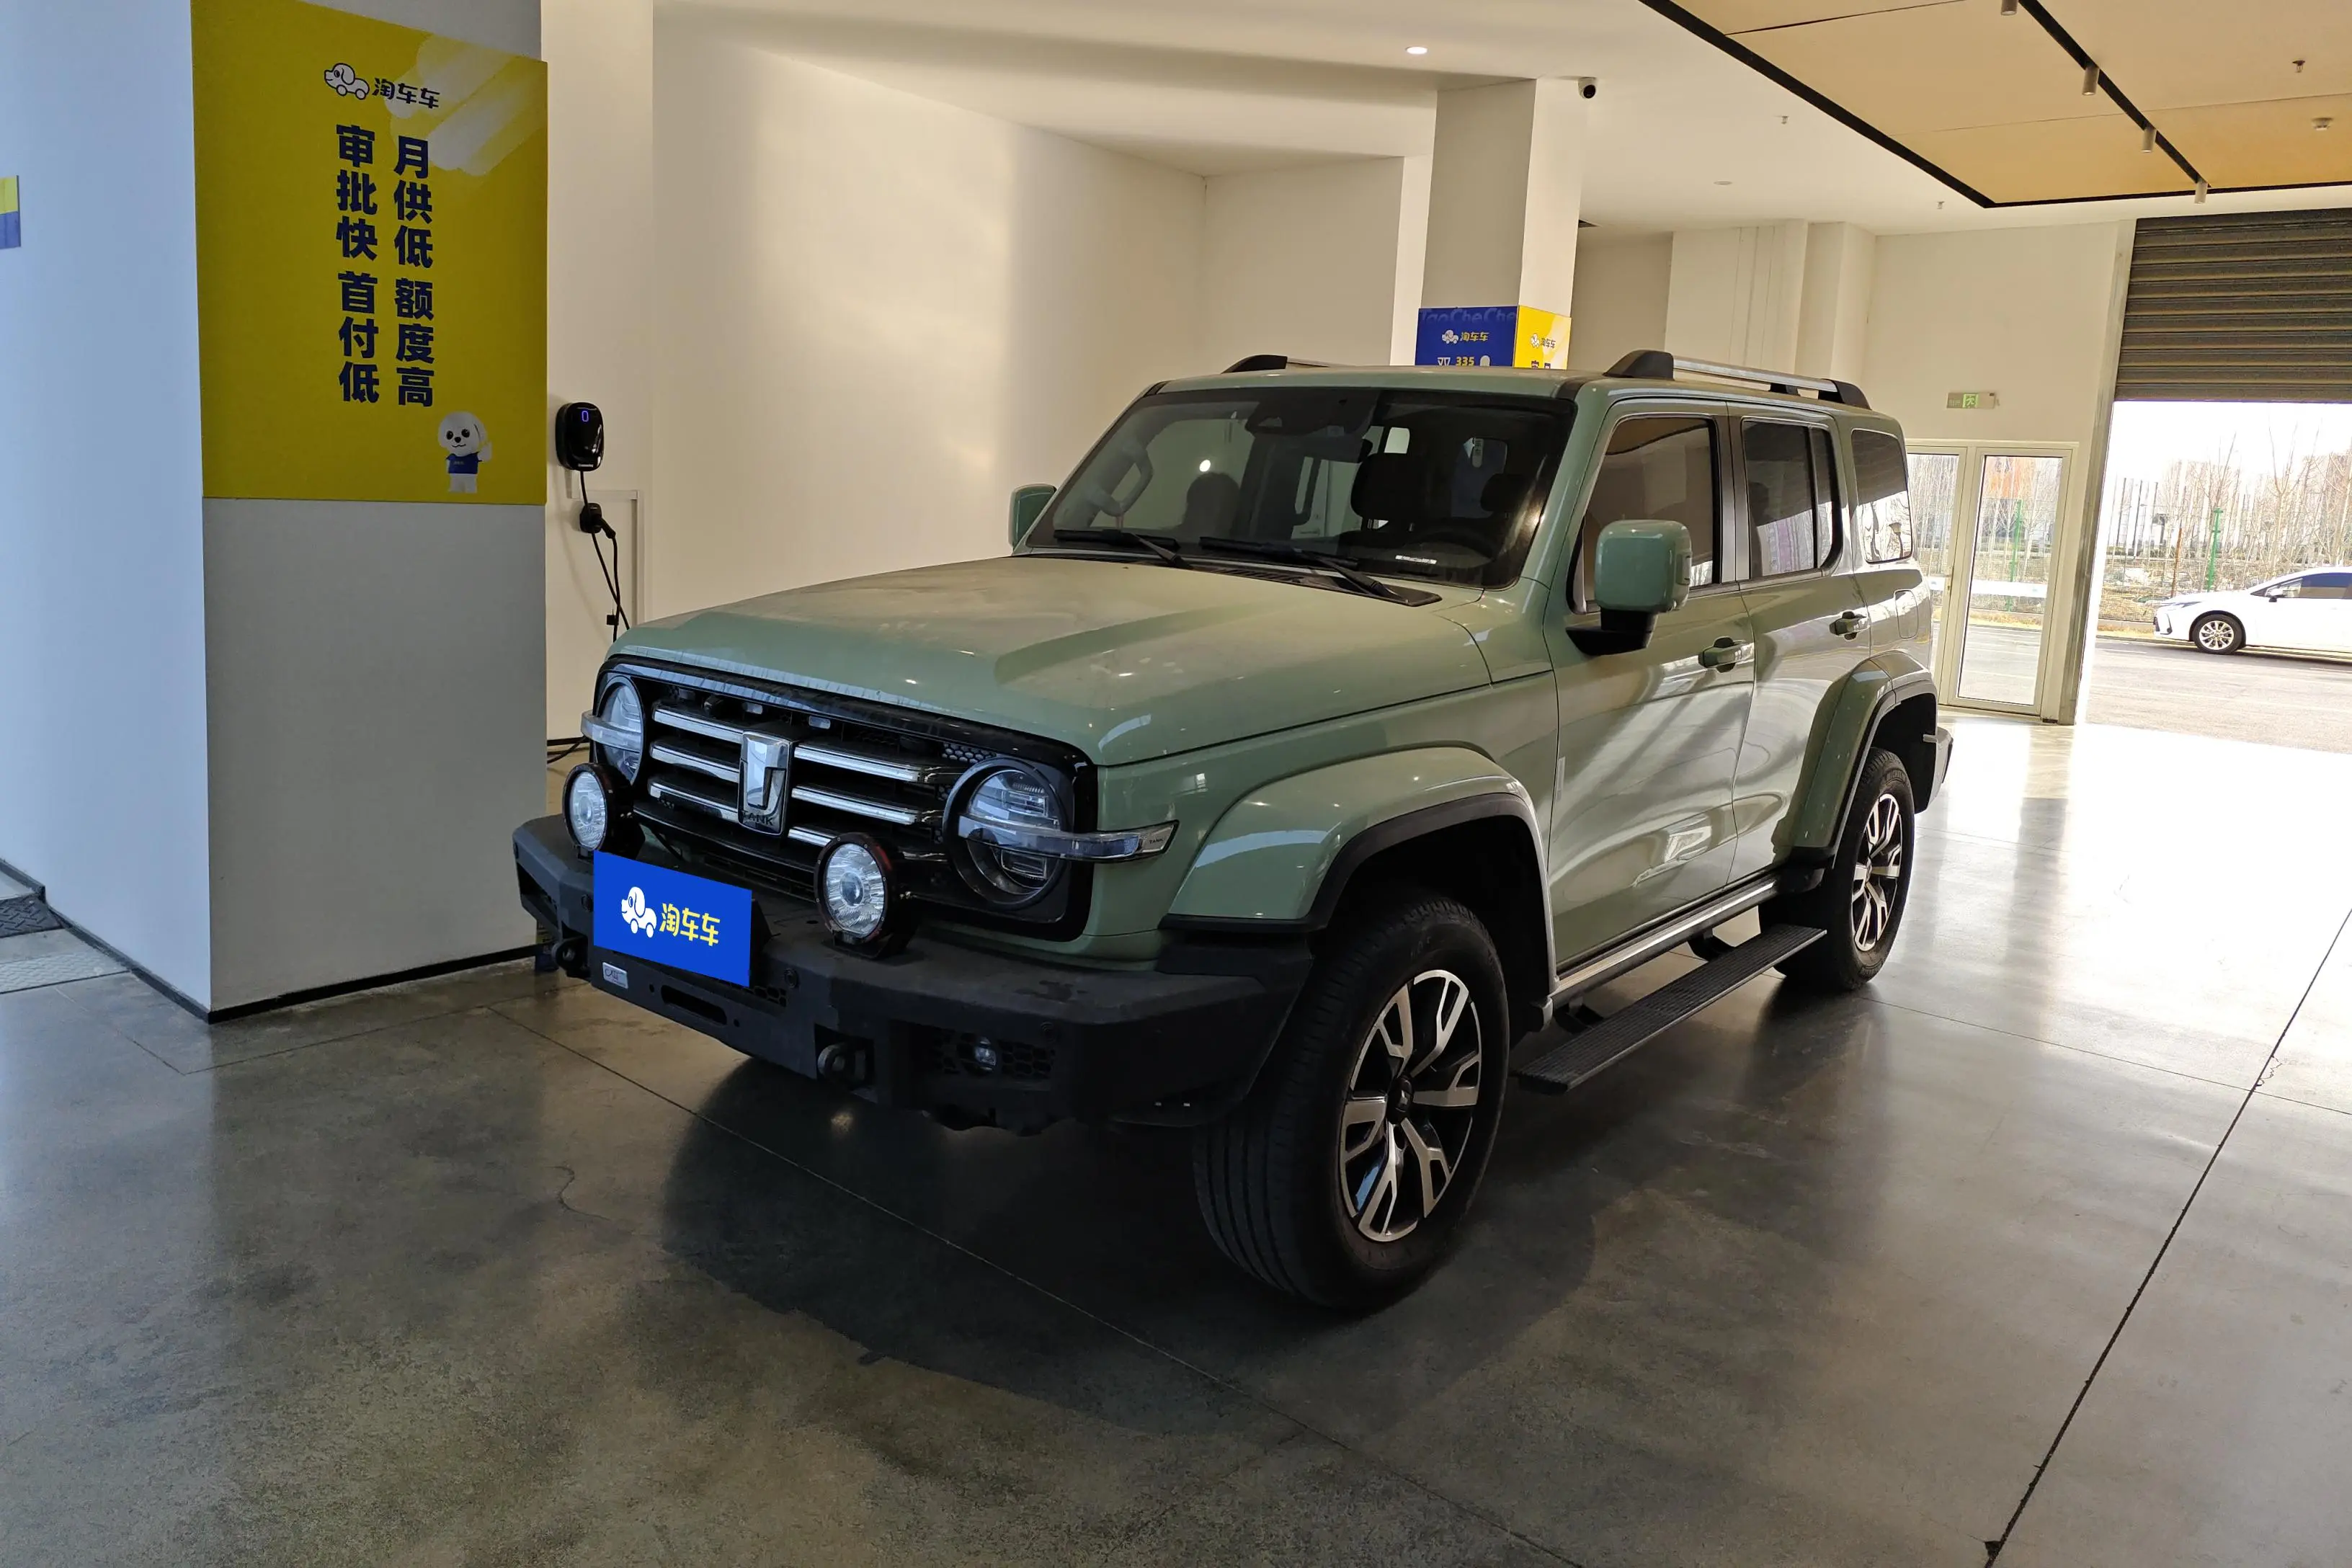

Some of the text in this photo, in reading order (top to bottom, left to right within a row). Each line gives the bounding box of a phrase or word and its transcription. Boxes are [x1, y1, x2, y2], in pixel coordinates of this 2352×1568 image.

[372, 77, 440, 109] 淘车车
[335, 123, 380, 404] 审批快 首付低
[393, 135, 435, 408] 月供低 额度高
